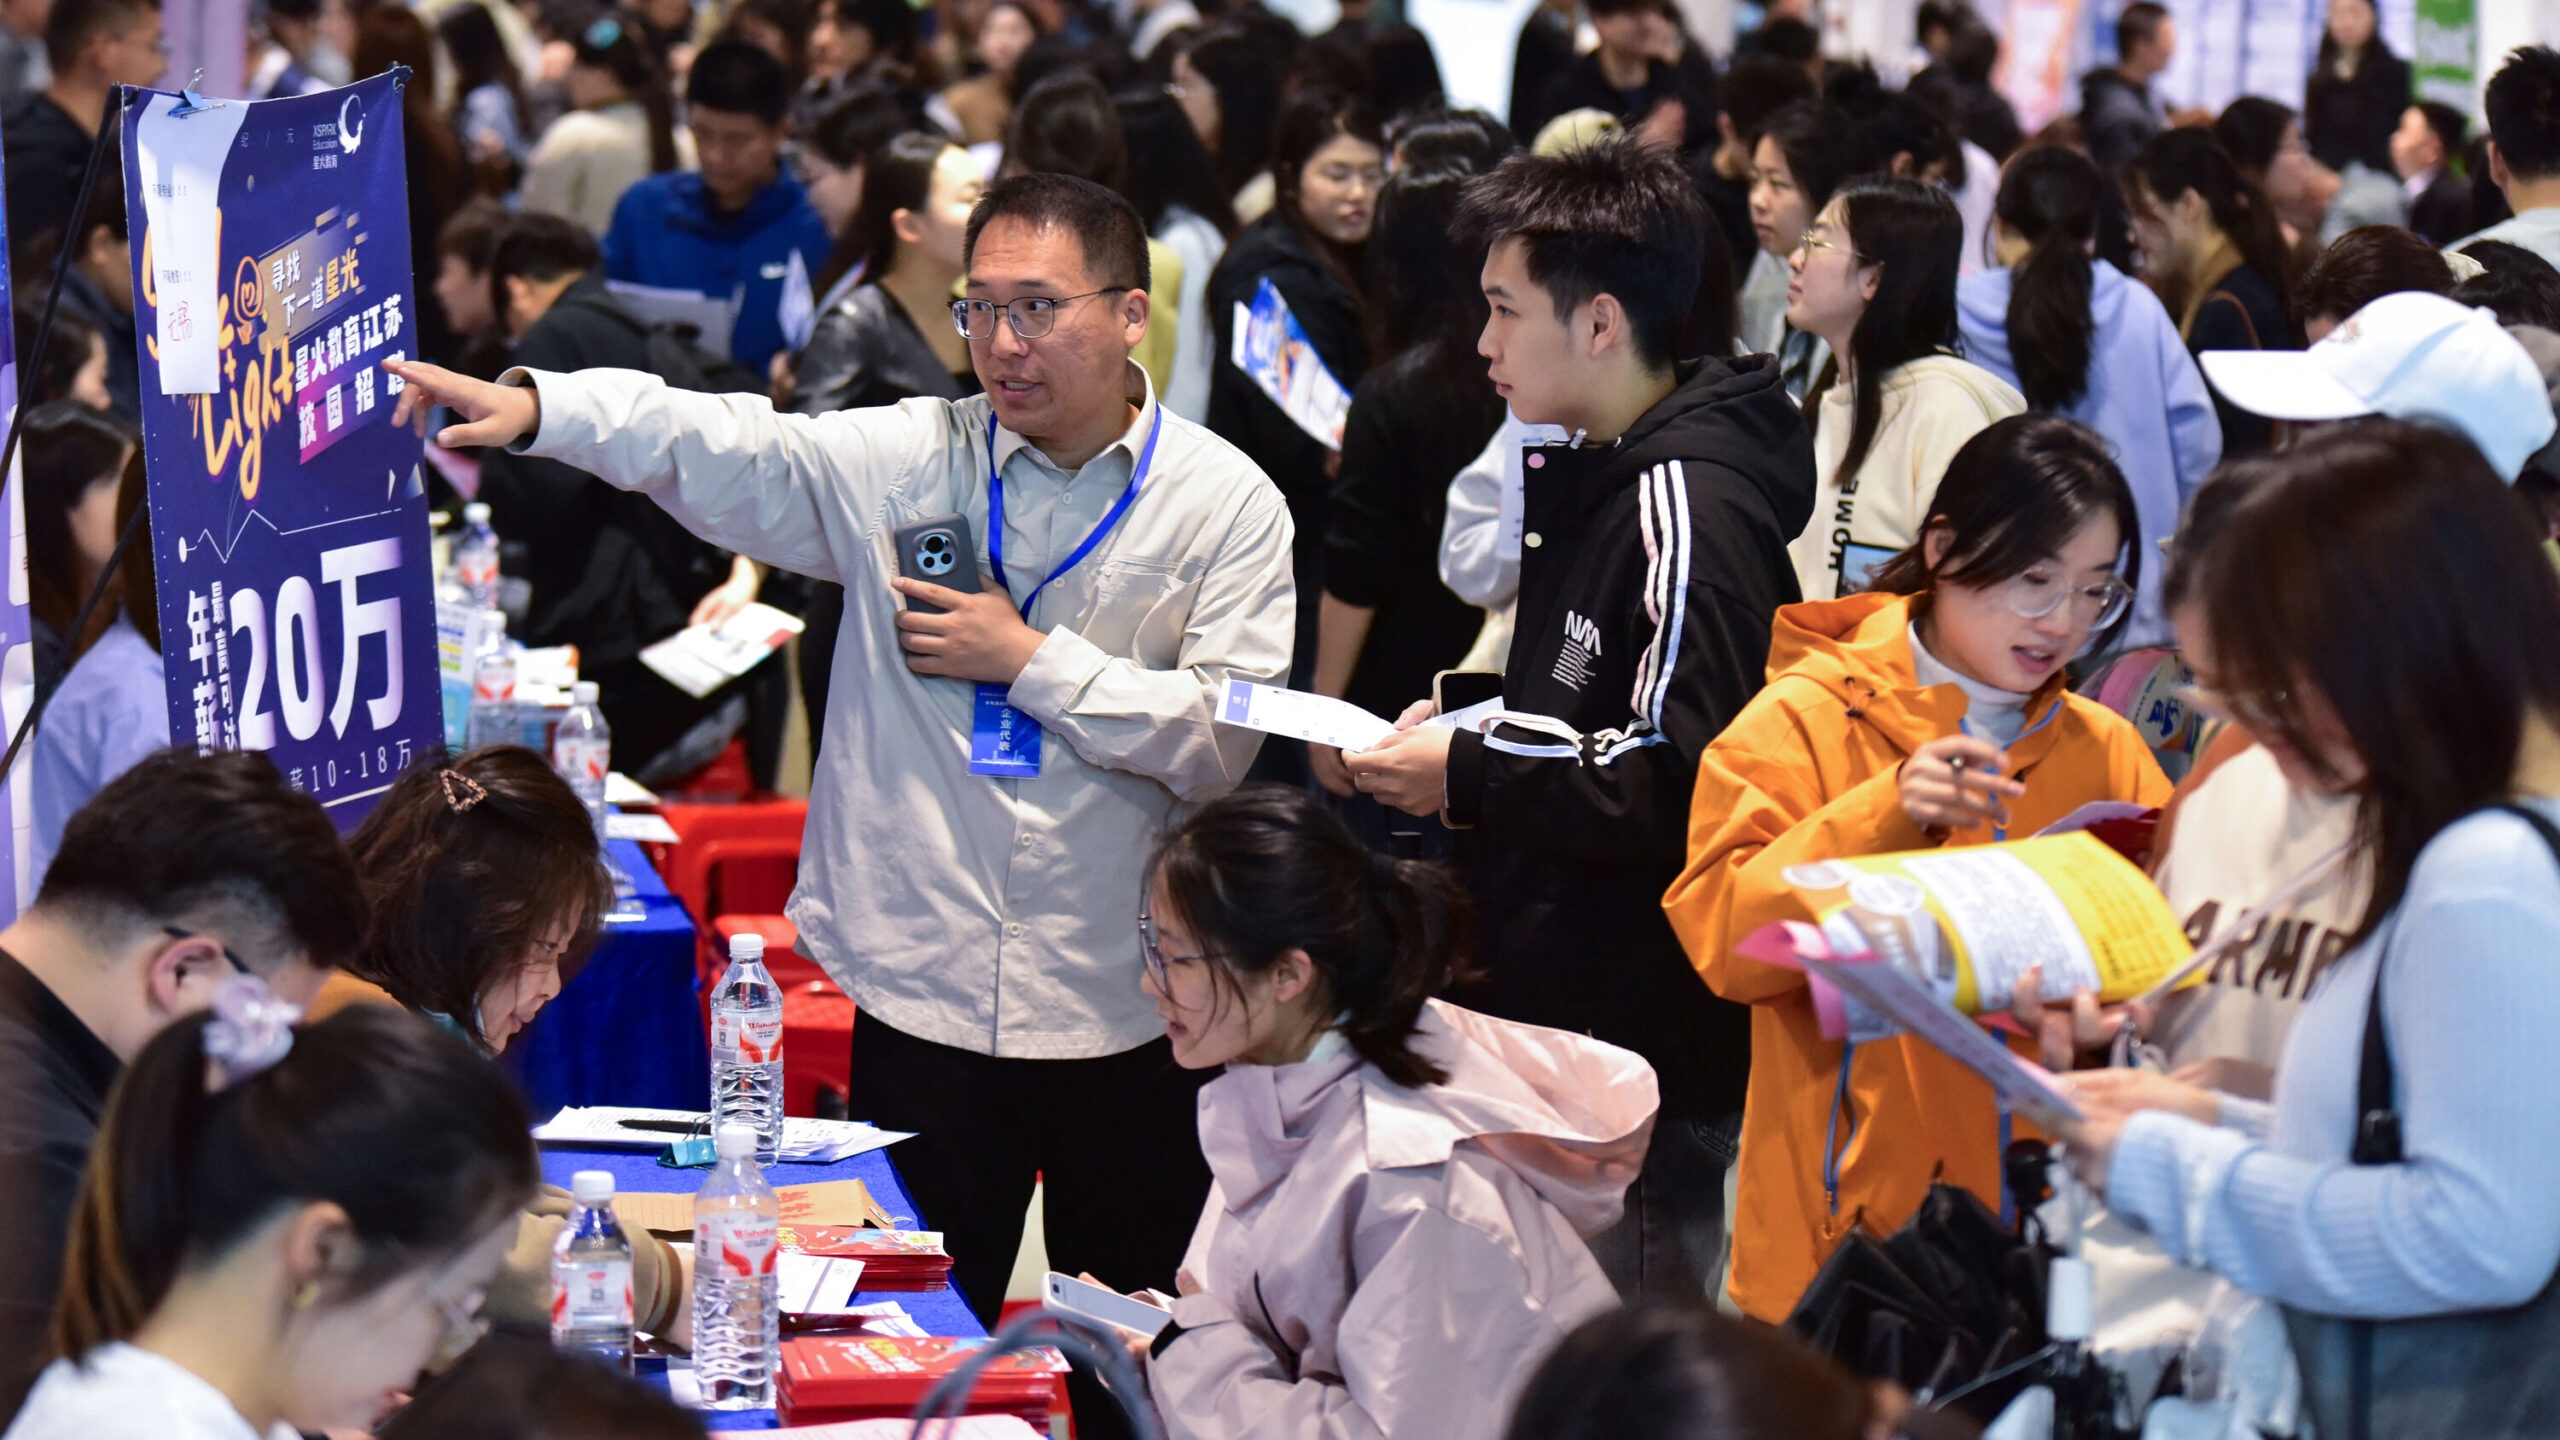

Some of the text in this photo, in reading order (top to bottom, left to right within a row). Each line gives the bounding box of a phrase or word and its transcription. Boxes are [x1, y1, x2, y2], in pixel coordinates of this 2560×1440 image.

[312, 154, 338, 170] 星火教育
[272, 250, 300, 293] 寻找
[282, 247, 360, 328] 下一道星光
[295, 294, 403, 392] 星火教育江苏
[229, 537, 404, 752] 20万
[998, 708, 1012, 751] 企业代表
